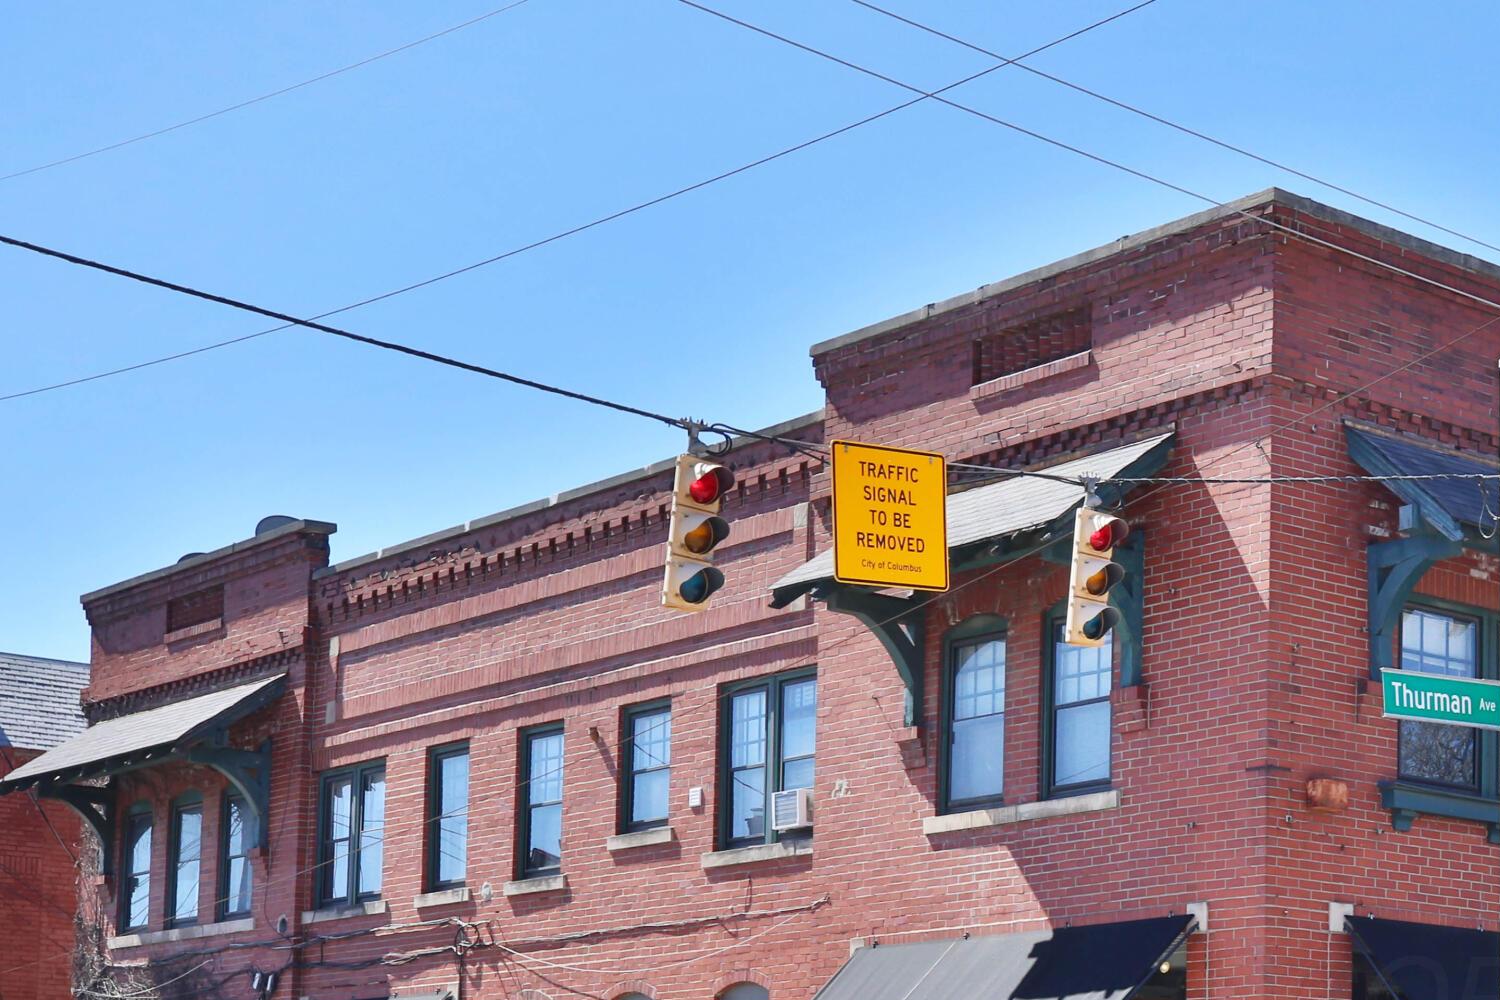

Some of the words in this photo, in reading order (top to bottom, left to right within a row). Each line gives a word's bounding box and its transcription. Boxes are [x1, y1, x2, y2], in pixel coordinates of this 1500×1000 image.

[858, 461, 918, 483] TRAFFIC
[863, 486, 916, 506] SIGNAL
[869, 510, 887, 526] TO
[894, 513, 911, 529] BE
[857, 532, 925, 553] REMOVED
[862, 559, 875, 569] City
[878, 561, 885, 569] of
[888, 561, 922, 572] Columbus
[1392, 681, 1472, 715] Thurman
[1479, 698, 1496, 712] Ave
